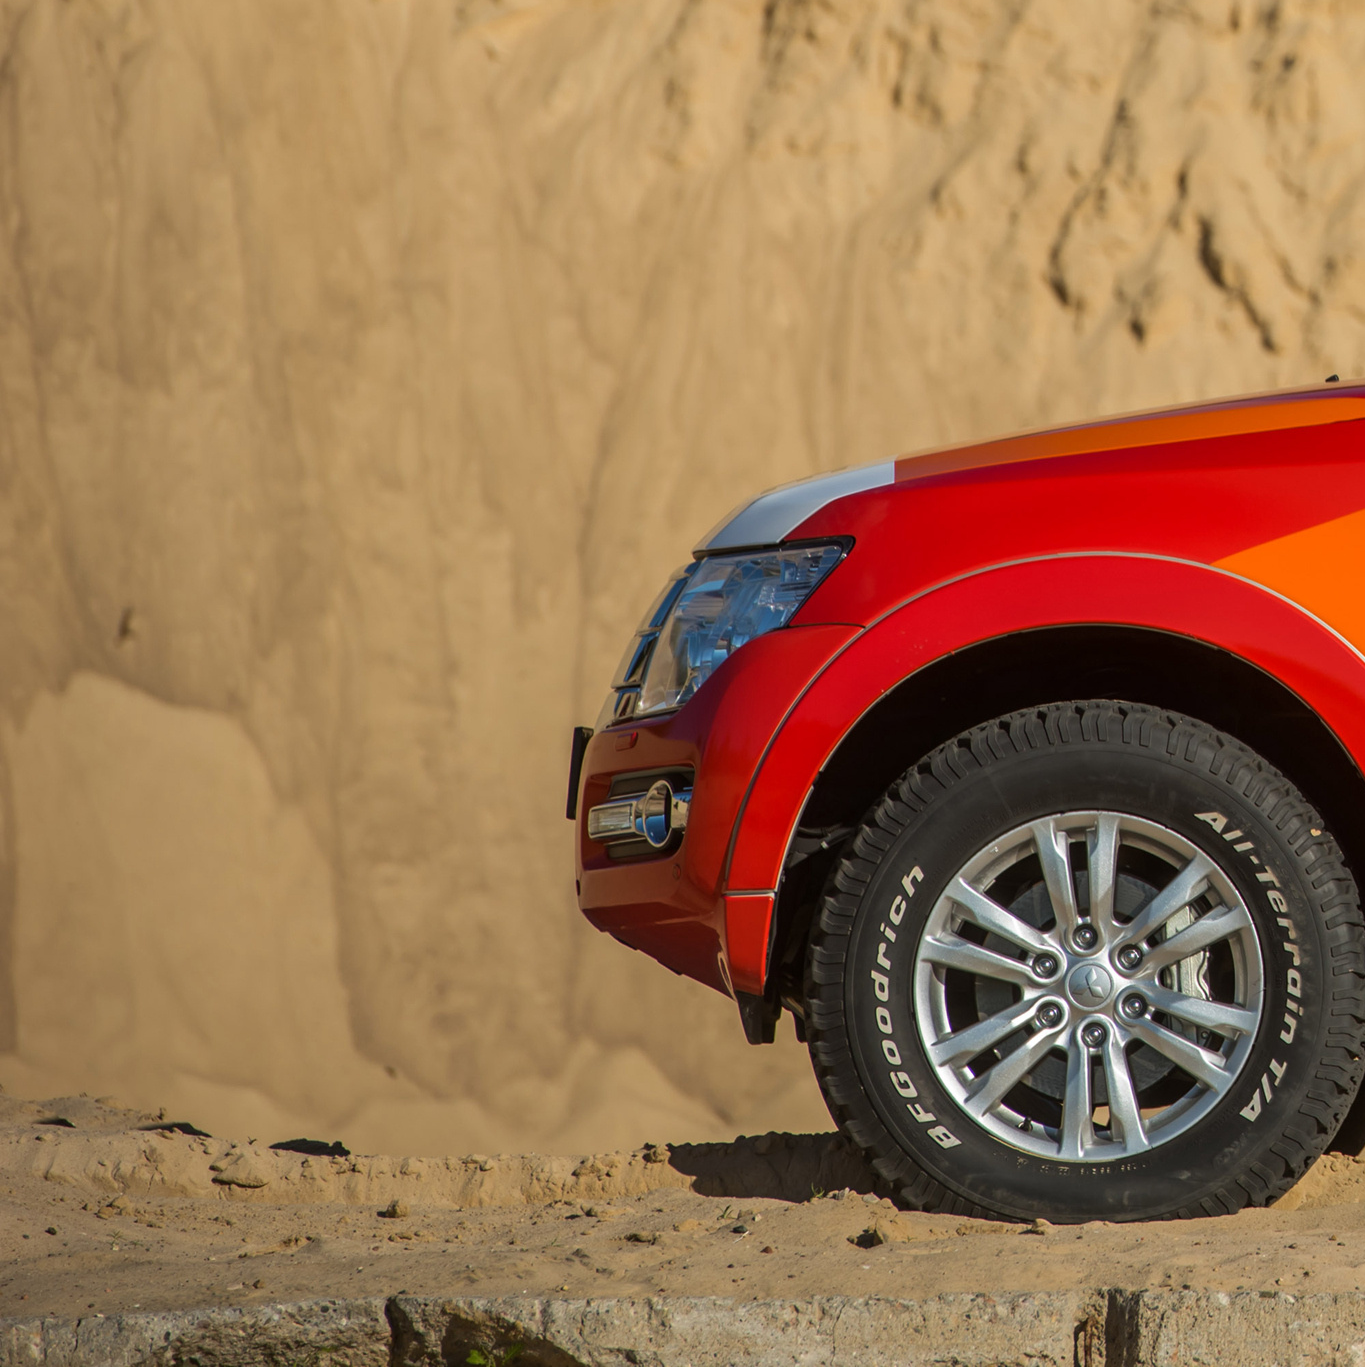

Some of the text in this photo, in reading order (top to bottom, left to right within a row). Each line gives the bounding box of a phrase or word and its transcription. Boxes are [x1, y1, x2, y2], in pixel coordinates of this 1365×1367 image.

[870, 864, 962, 1149] BFGoodrich
[1193, 811, 1306, 1122] All-Terrain T/A
